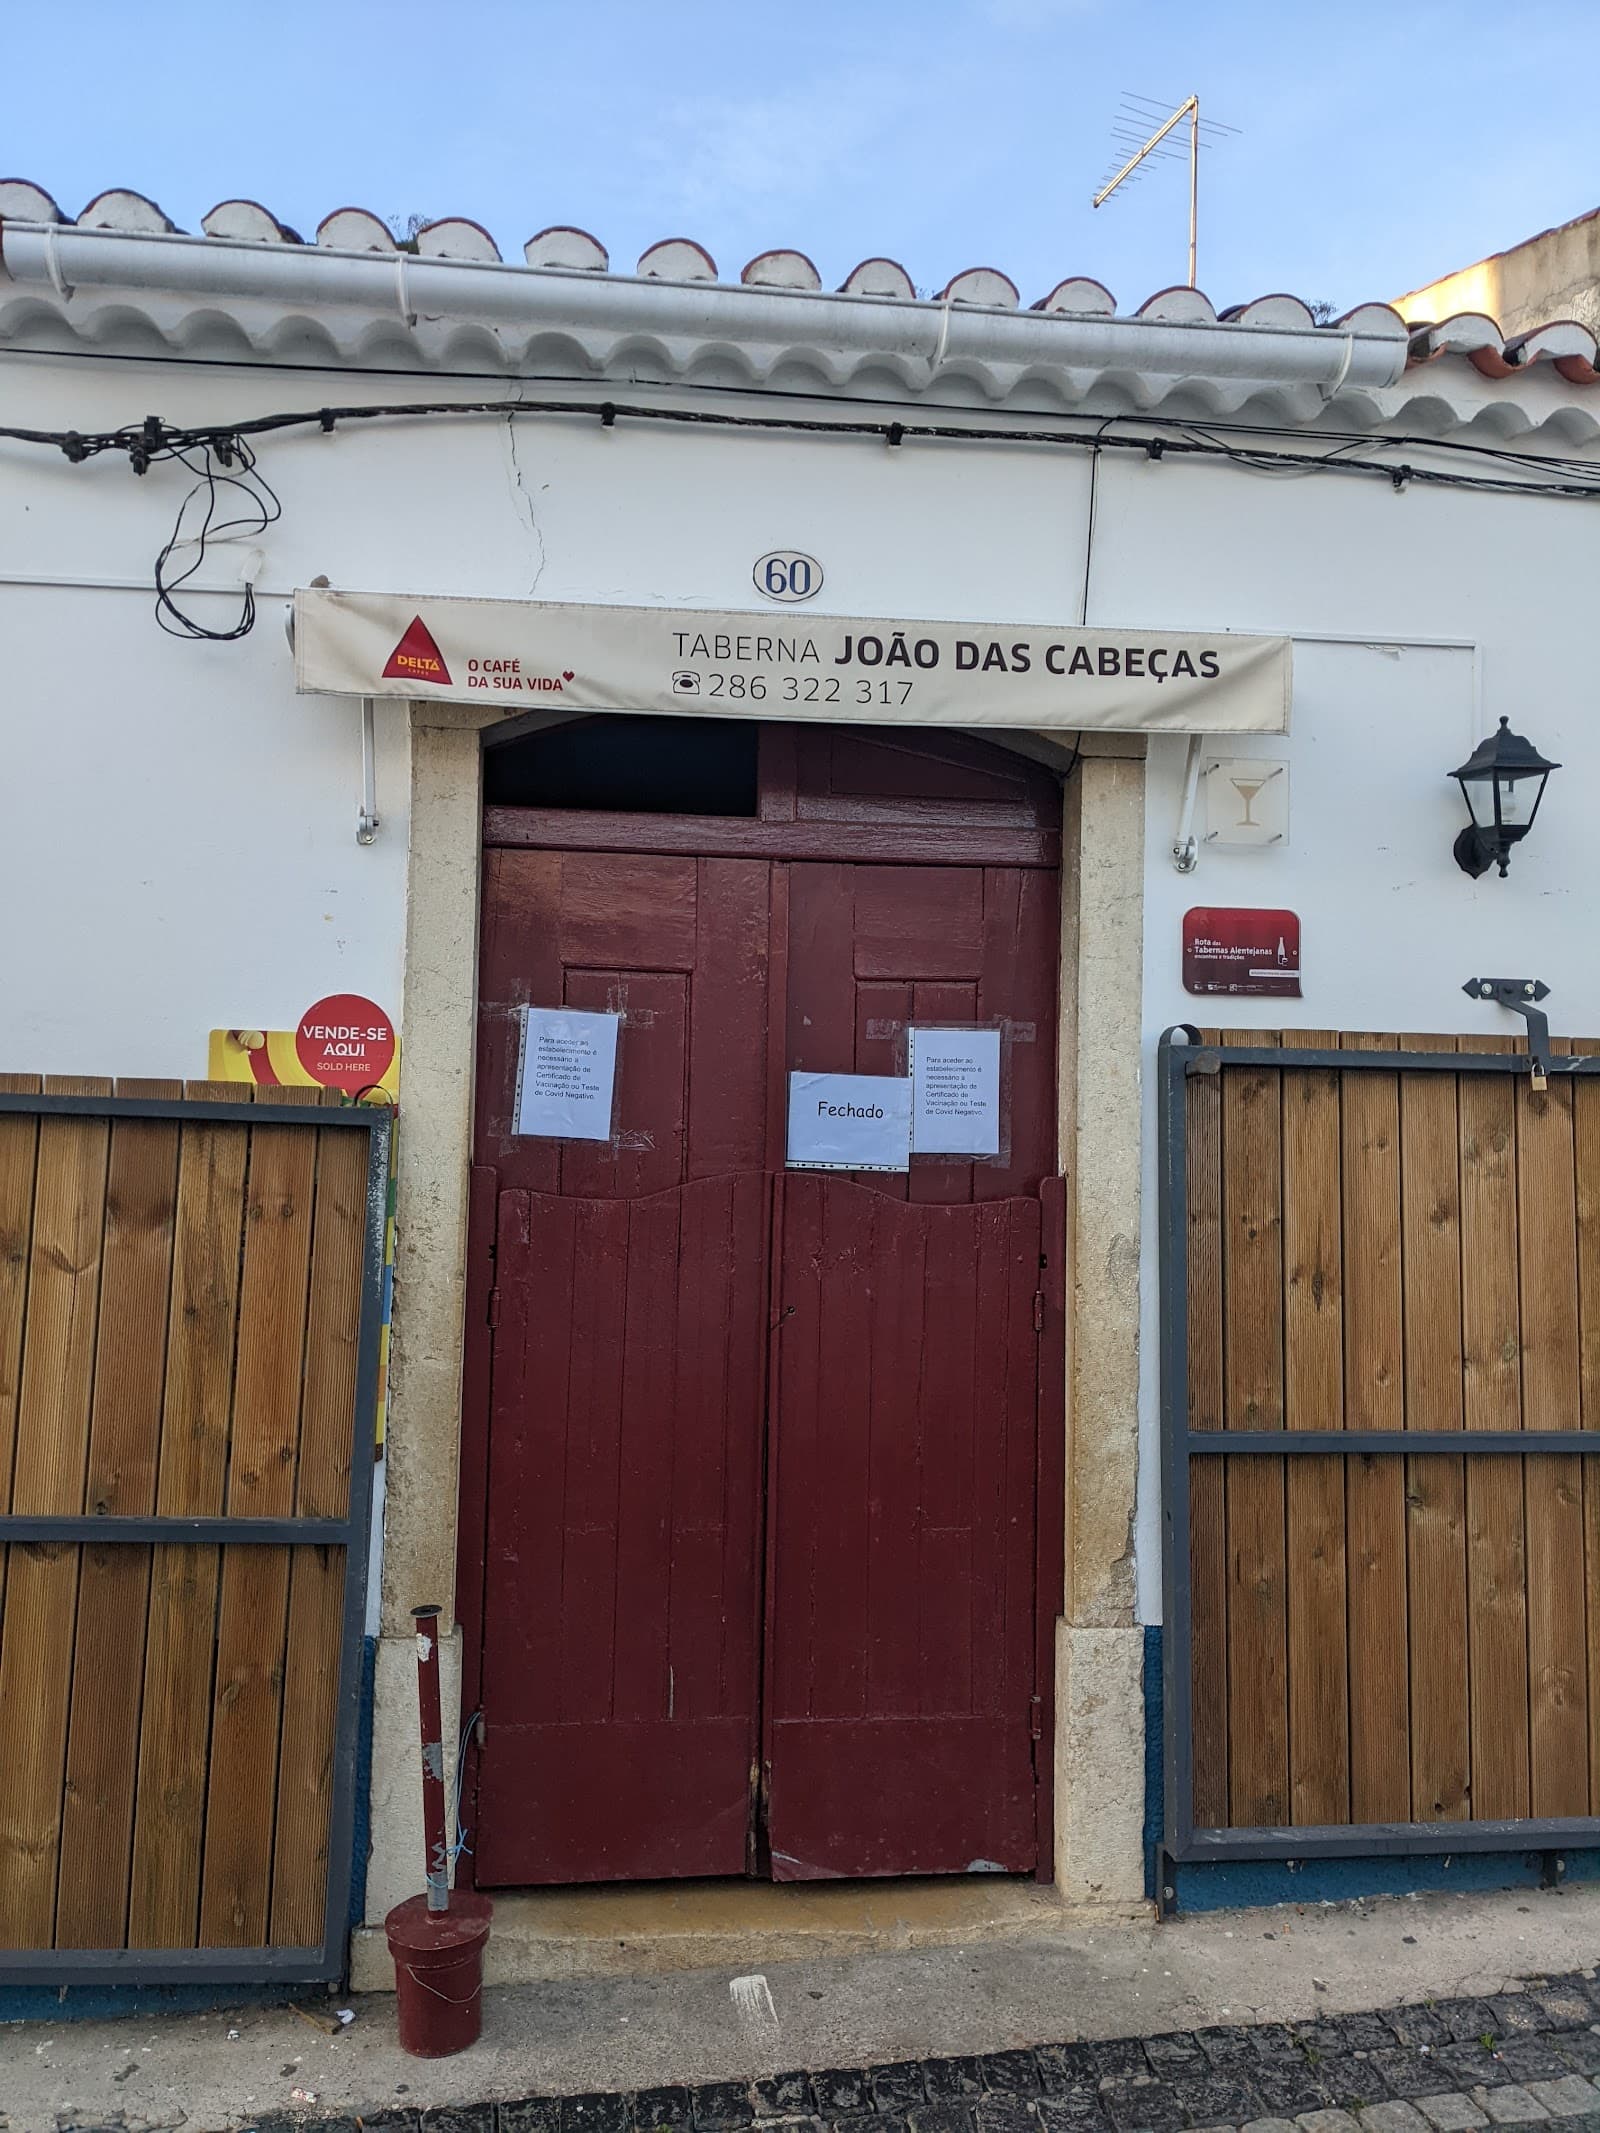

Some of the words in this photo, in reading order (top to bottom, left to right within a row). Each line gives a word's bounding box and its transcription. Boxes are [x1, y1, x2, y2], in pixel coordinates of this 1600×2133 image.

[766, 558, 812, 595] 60
[397, 655, 440, 671] DELTA
[672, 632, 821, 664] TABERNA
[834, 631, 939, 669] JOÃO
[955, 639, 1032, 673] DAS
[1044, 644, 1222, 684] CABEÇAS
[468, 659, 479, 672] O
[483, 658, 521, 673] CAFÉ
[468, 676, 488, 688] DA
[493, 677, 523, 689] SUA
[527, 678, 563, 691] VIDA
[708, 672, 768, 701] 286
[782, 677, 842, 704] 322
[855, 680, 914, 706] 317
[1194, 946, 1229, 954] Tabernas
[1230, 946, 1273, 956] Alentejanas
[303, 1025, 387, 1041] VENDE-SE
[539, 1036, 555, 1044] Para
[323, 1043, 365, 1057] AQUI
[317, 1062, 343, 1072] SOLD
[345, 1063, 371, 1072] HERE
[544, 1090, 563, 1098] Covid
[581, 1083, 600, 1091] Teste
[818, 1101, 884, 1118] Fechado
